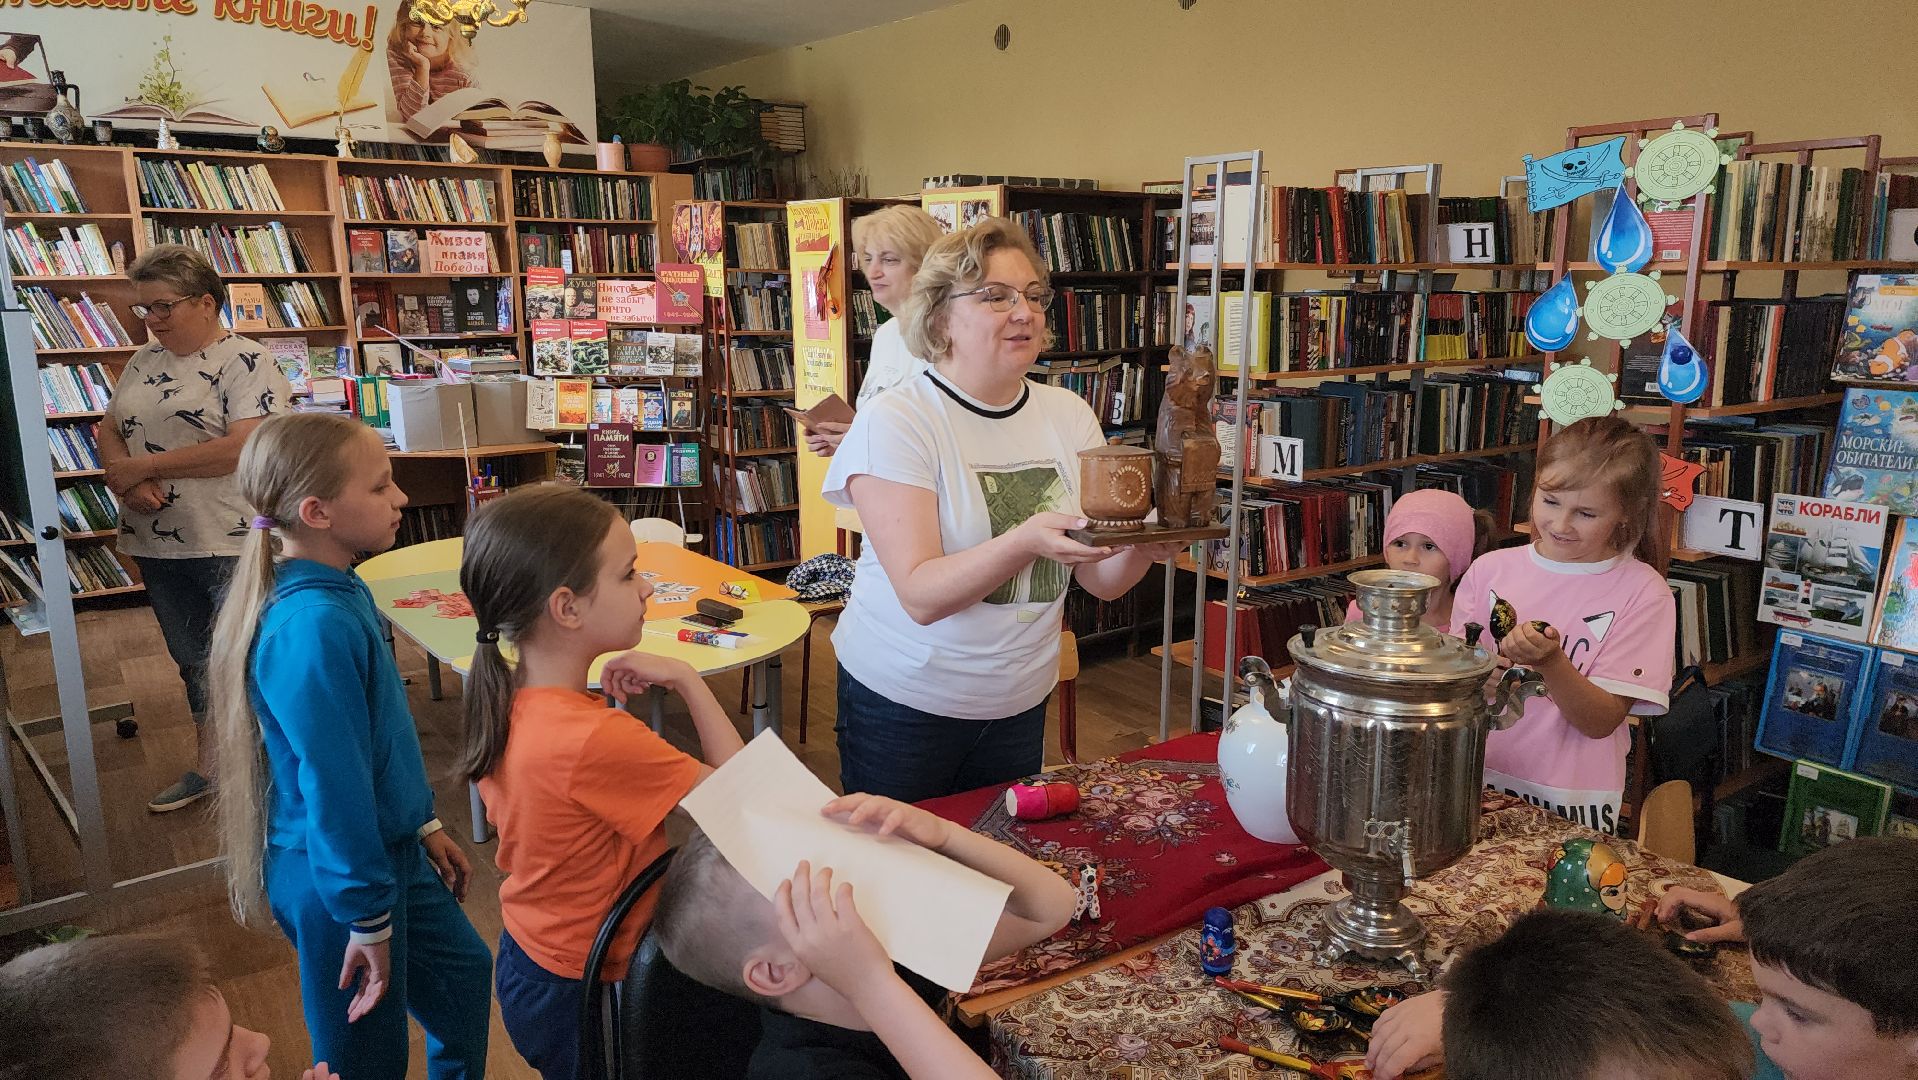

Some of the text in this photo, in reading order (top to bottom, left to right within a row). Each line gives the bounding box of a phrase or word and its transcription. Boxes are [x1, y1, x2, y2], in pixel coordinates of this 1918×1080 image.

[430, 231, 483, 247] Живое
[1463, 228, 1490, 258] Н
[434, 260, 485, 272] Победы
[567, 280, 597, 288] ЖУКОВ
[597, 282, 632, 294] Никто
[601, 296, 646, 304] не забыт
[598, 305, 632, 314] ничто
[610, 314, 622, 322] не
[1840, 435, 1906, 454] МОРСКИЕ
[1272, 442, 1298, 476] М
[1836, 451, 1914, 471] ОБИТАТЕЛИ
[1799, 501, 1881, 525] КОРАБЛИ
[1719, 508, 1755, 550] Т
